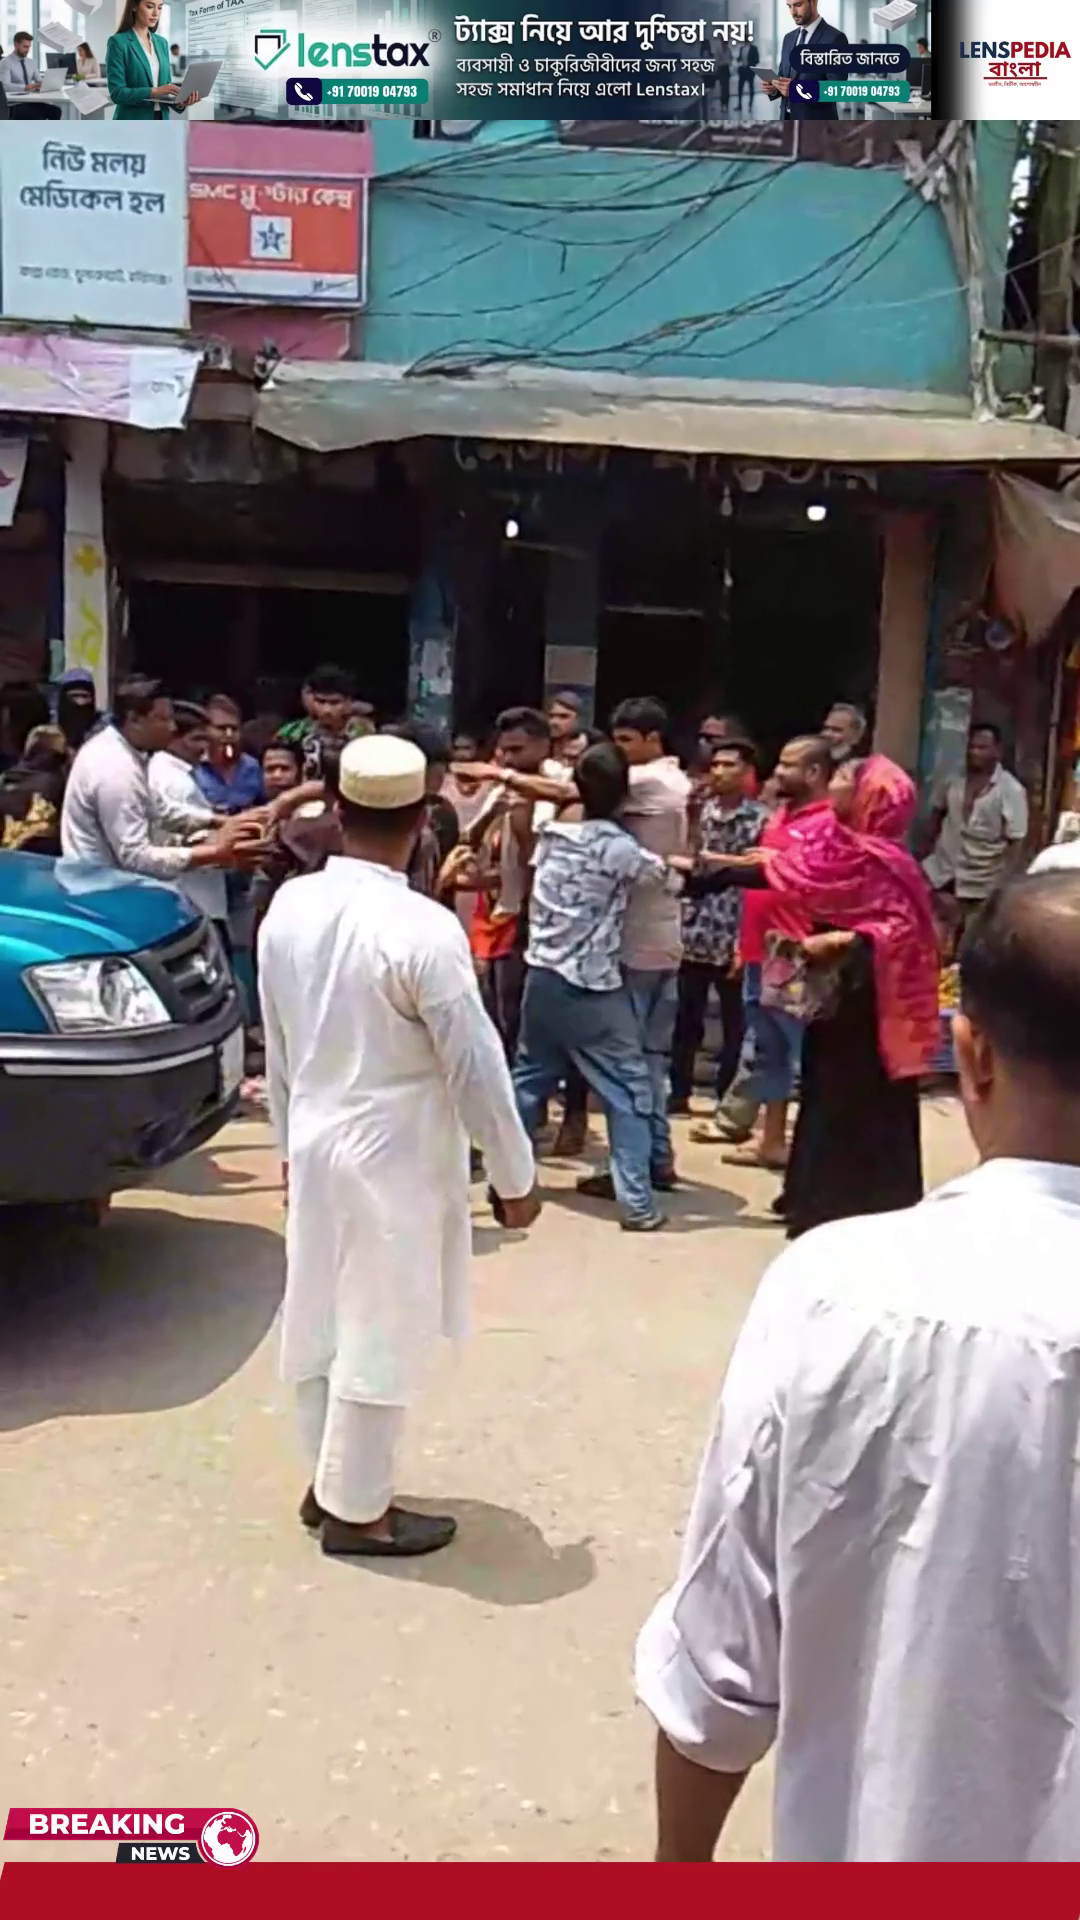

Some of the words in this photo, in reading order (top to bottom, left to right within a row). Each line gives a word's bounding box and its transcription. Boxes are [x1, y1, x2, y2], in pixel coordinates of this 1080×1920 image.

[43, 140, 86, 172] নিউ
[91, 152, 146, 178] মলয়
[20, 179, 124, 212] মেডিকেল
[127, 191, 166, 215] হল
